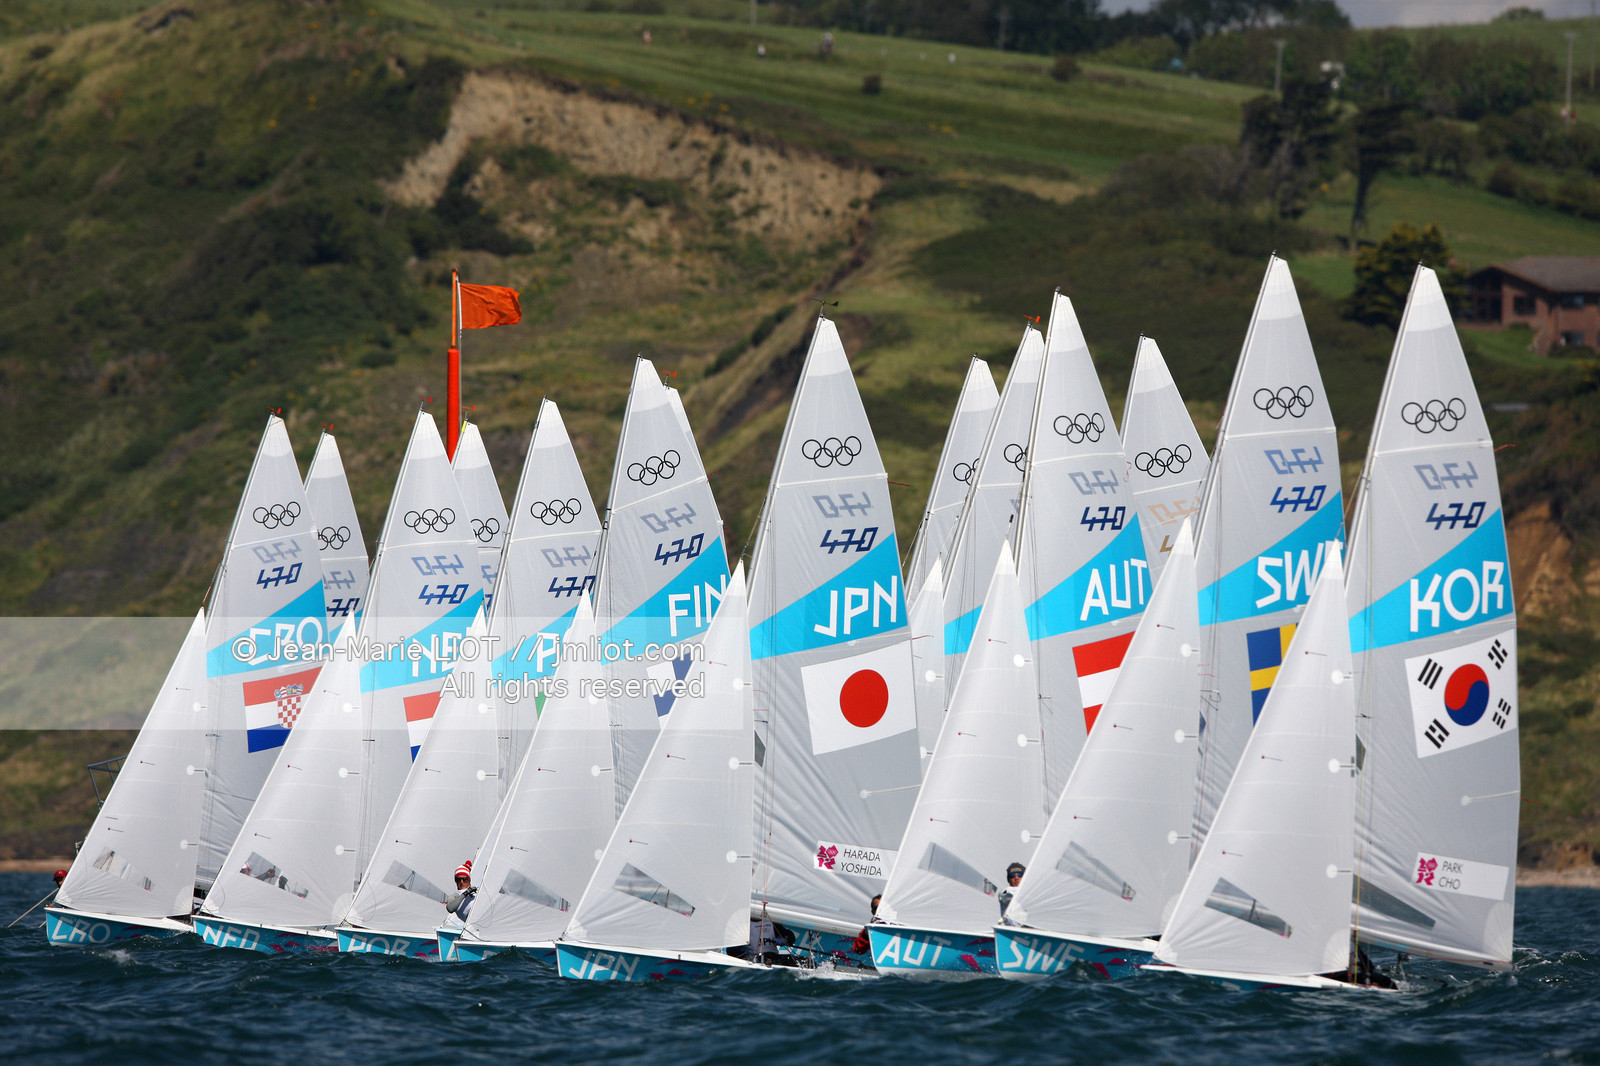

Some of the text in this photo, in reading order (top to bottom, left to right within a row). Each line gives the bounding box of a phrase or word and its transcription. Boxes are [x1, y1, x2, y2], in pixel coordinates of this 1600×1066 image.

[1269, 485, 1326, 513] 470
[1080, 506, 1126, 531] 470
[1426, 501, 1486, 530] 470
[654, 532, 704, 565] 470
[819, 526, 879, 554] 470
[256, 562, 303, 589] 470
[1080, 558, 1147, 621] AUT
[418, 584, 469, 605] 470
[668, 574, 727, 637] FIN
[813, 575, 898, 637] JPN
[1410, 560, 1504, 632] KOR
[247, 616, 323, 666] CRO
[840, 862, 882, 876] YOSHIDA
[843, 849, 881, 861] HARADA
[1442, 861, 1463, 874] PARK
[1438, 876, 1461, 890] CHO
[51, 916, 111, 943] CRO
[202, 923, 260, 950] NED
[876, 933, 952, 966] AUT
[568, 950, 640, 981] JPN
